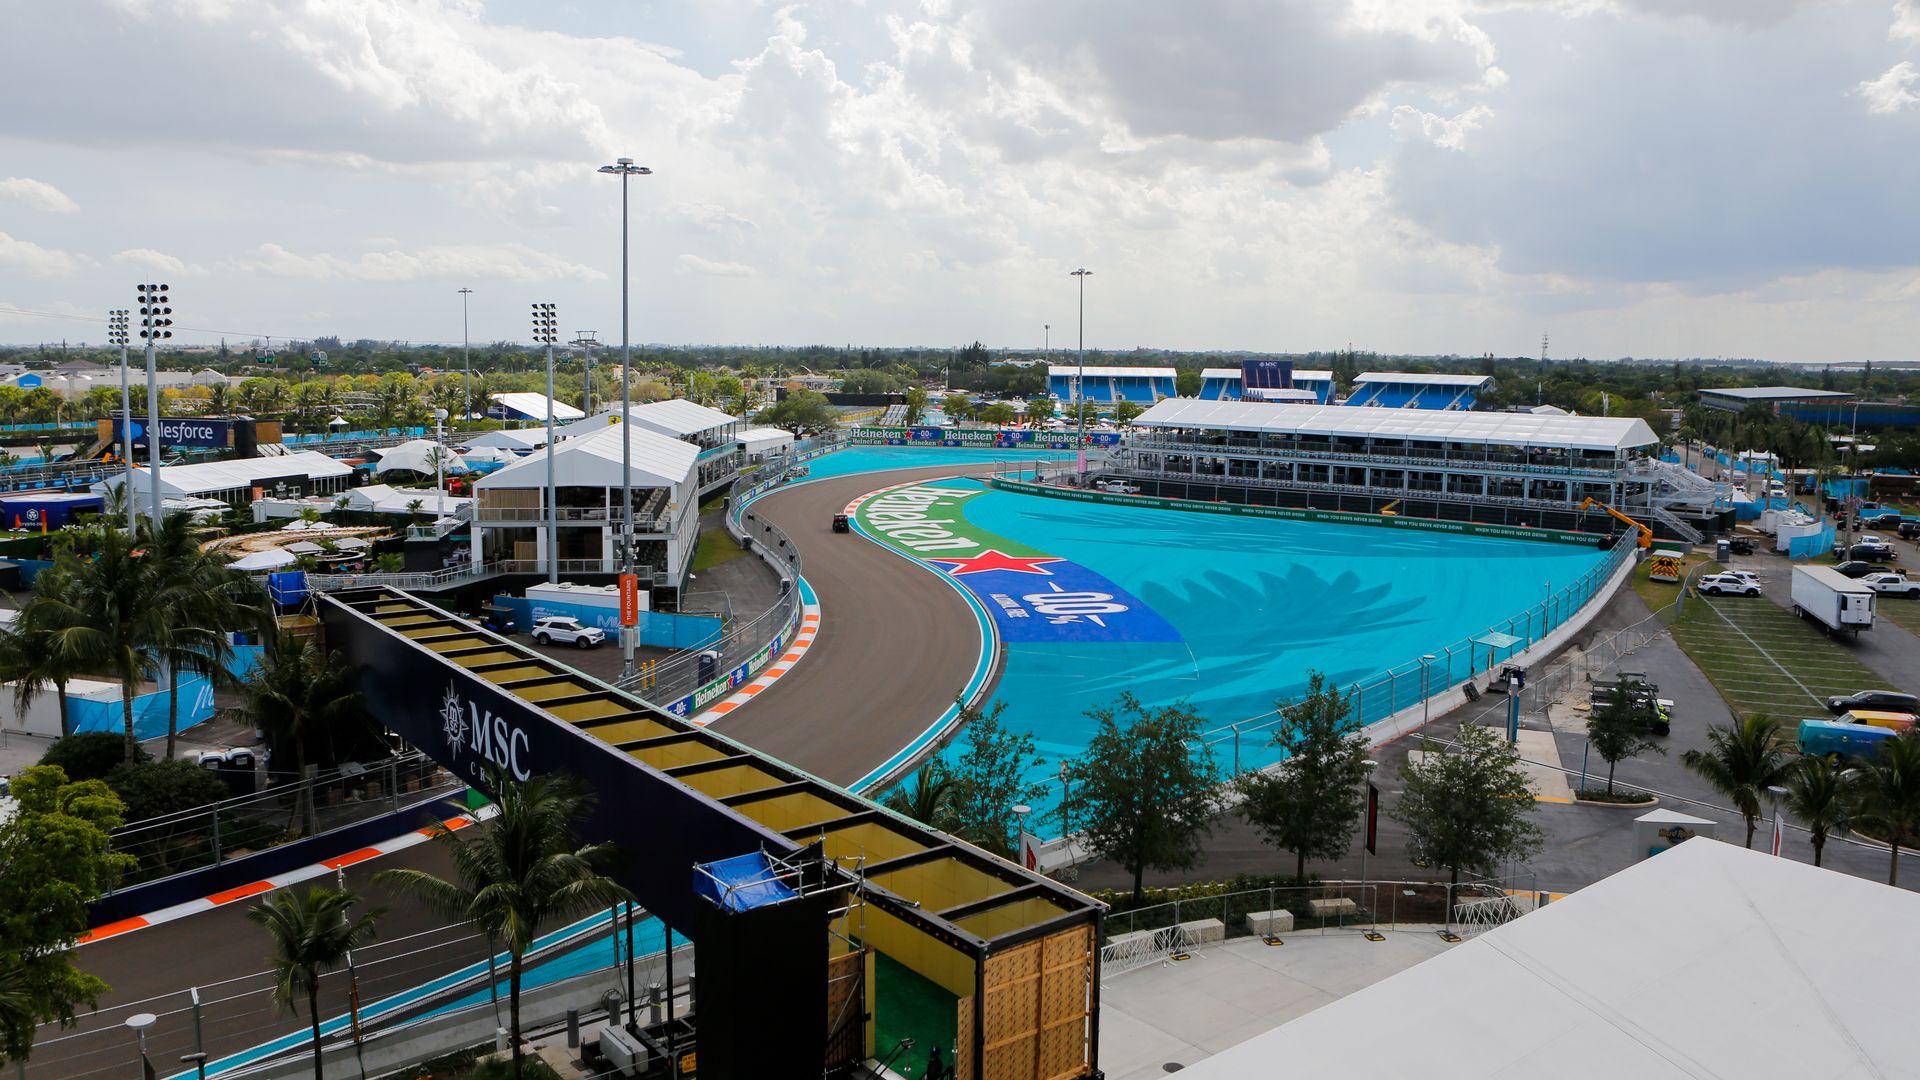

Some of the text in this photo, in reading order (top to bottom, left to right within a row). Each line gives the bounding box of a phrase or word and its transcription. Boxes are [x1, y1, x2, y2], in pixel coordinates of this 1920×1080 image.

[146, 422, 213, 443] slesforce
[852, 428, 901, 439] Heineken
[944, 430, 992, 441] Heineken
[866, 486, 984, 551] Heineken
[695, 680, 727, 709] Heineken
[468, 700, 531, 782] MSC
